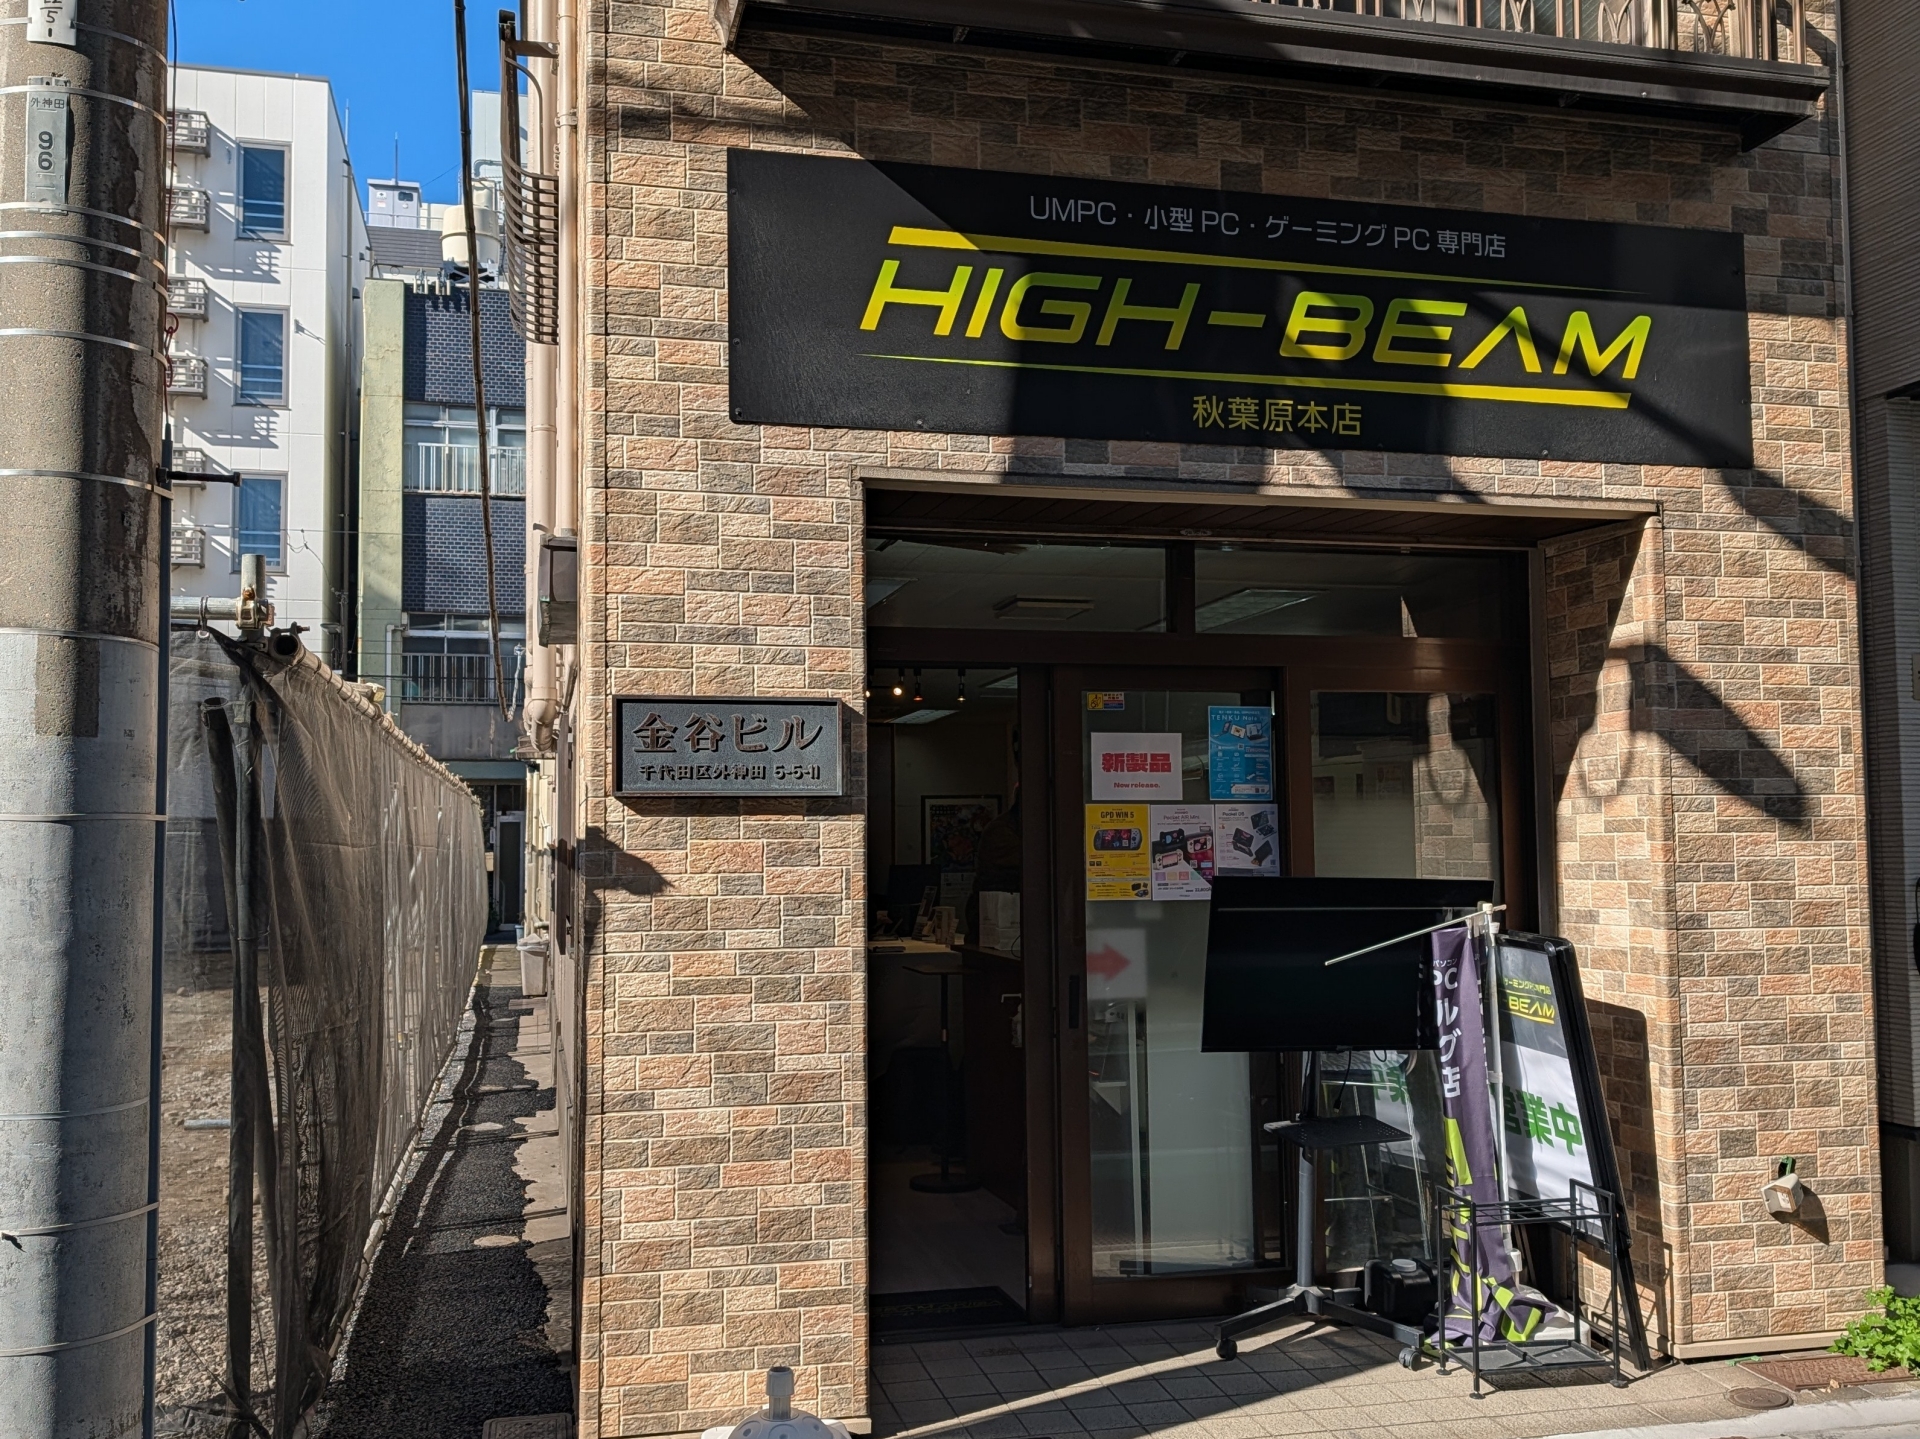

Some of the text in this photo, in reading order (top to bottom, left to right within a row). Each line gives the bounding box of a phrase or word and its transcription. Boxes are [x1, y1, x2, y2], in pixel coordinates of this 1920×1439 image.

[30, 97, 65, 109] 外神田
[38, 131, 53, 171] 96
[860, 258, 1652, 380] HIGH-BEAM
[1192, 395, 1363, 437] 秋葉原本店
[632, 711, 824, 754] 金谷ビル
[640, 763, 767, 781] 千代田区外神田
[1101, 752, 1172, 773] 新製品
[1100, 811, 1135, 819] GPD WIN 5
[1433, 958, 1458, 968] パソコン
